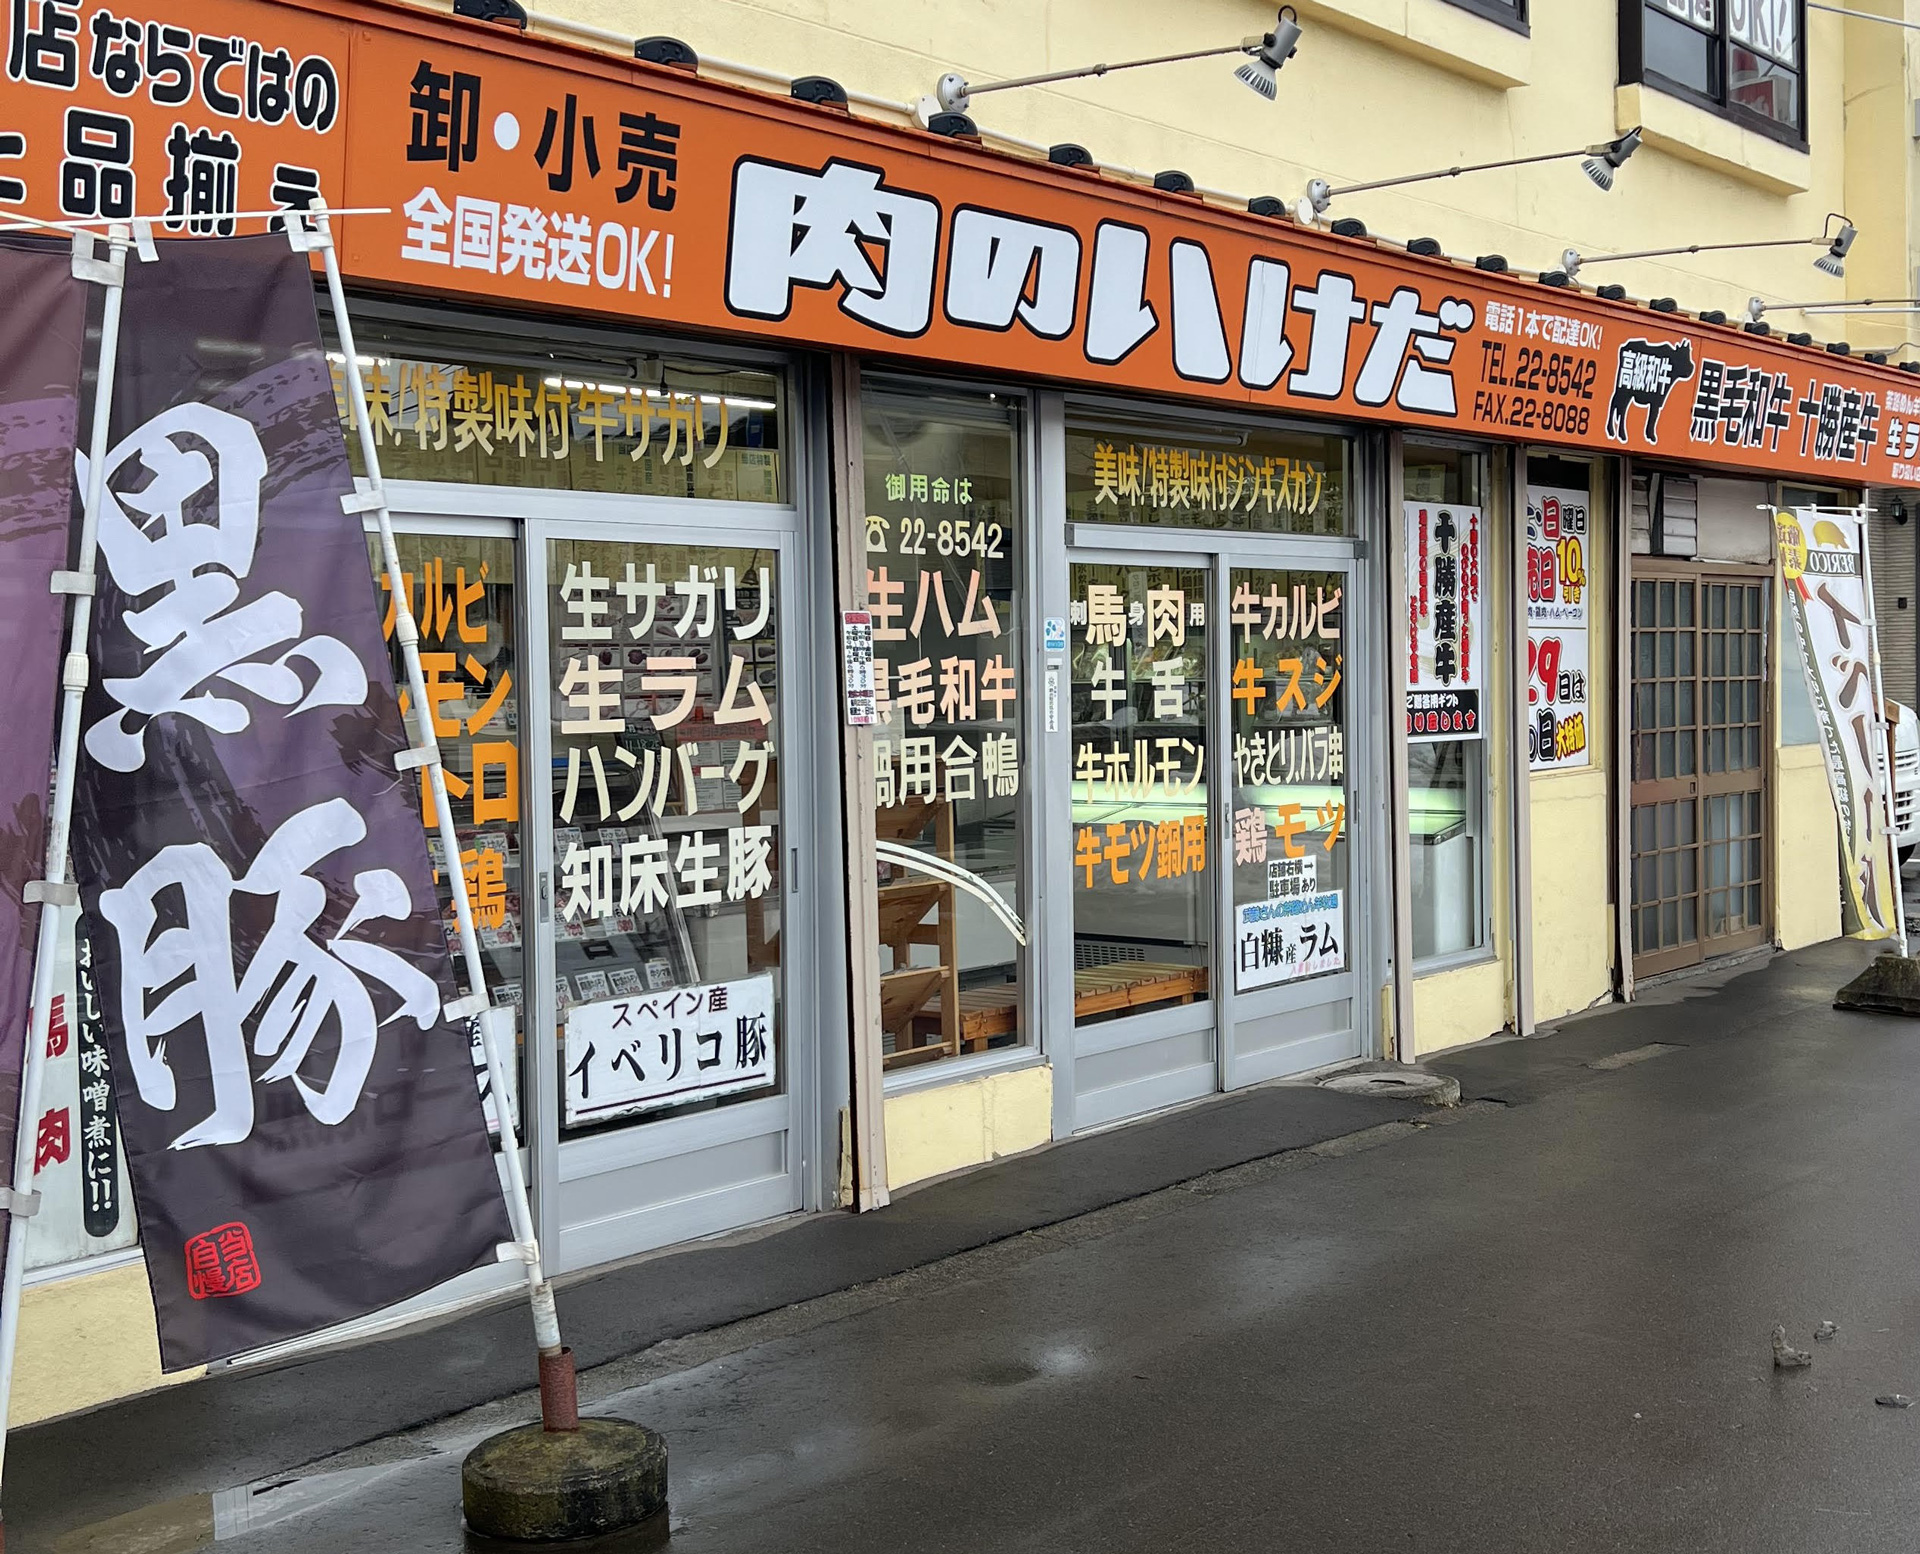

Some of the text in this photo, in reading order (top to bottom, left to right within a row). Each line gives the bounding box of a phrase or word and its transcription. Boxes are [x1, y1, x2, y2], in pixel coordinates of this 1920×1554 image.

[6, 0, 339, 133] 店ならではの
[401, 186, 673, 299] 全国発送OK!
[724, 154, 1475, 419] 肉のいけだ
[1484, 301, 1603, 350] 電話1本で配達OK!
[1618, 350, 1673, 396] 高級和牛
[1690, 357, 1881, 466] 黒毛和牛 十勝産牛
[885, 473, 974, 505] 御用命は
[1094, 443, 1322, 515] 美味!特製味付ジンギスカン
[899, 517, 1005, 559] 22-8542
[559, 561, 771, 641] 生サガリ
[866, 566, 1002, 640] 生ハム
[1231, 581, 1343, 644] 牛カルビ
[1433, 510, 1457, 686] 十勝産牛
[398, 651, 513, 737] モン
[559, 654, 772, 734] 生ラム
[1090, 656, 1185, 720] 牛舌
[1232, 654, 1343, 715] 牛スジ
[75, 401, 442, 1151] 黒豚
[559, 740, 776, 824] ハンバーグ
[1075, 737, 1205, 804] 牛ホルモン
[1075, 814, 1205, 889] 牛モツ鍋用
[1234, 799, 1345, 867] 鶏モツ
[560, 825, 773, 923] 知床生豚
[1269, 877, 1317, 900] 駐車場あり
[611, 985, 729, 1029] スペイン産
[569, 1011, 768, 1100] イベリコ豚
